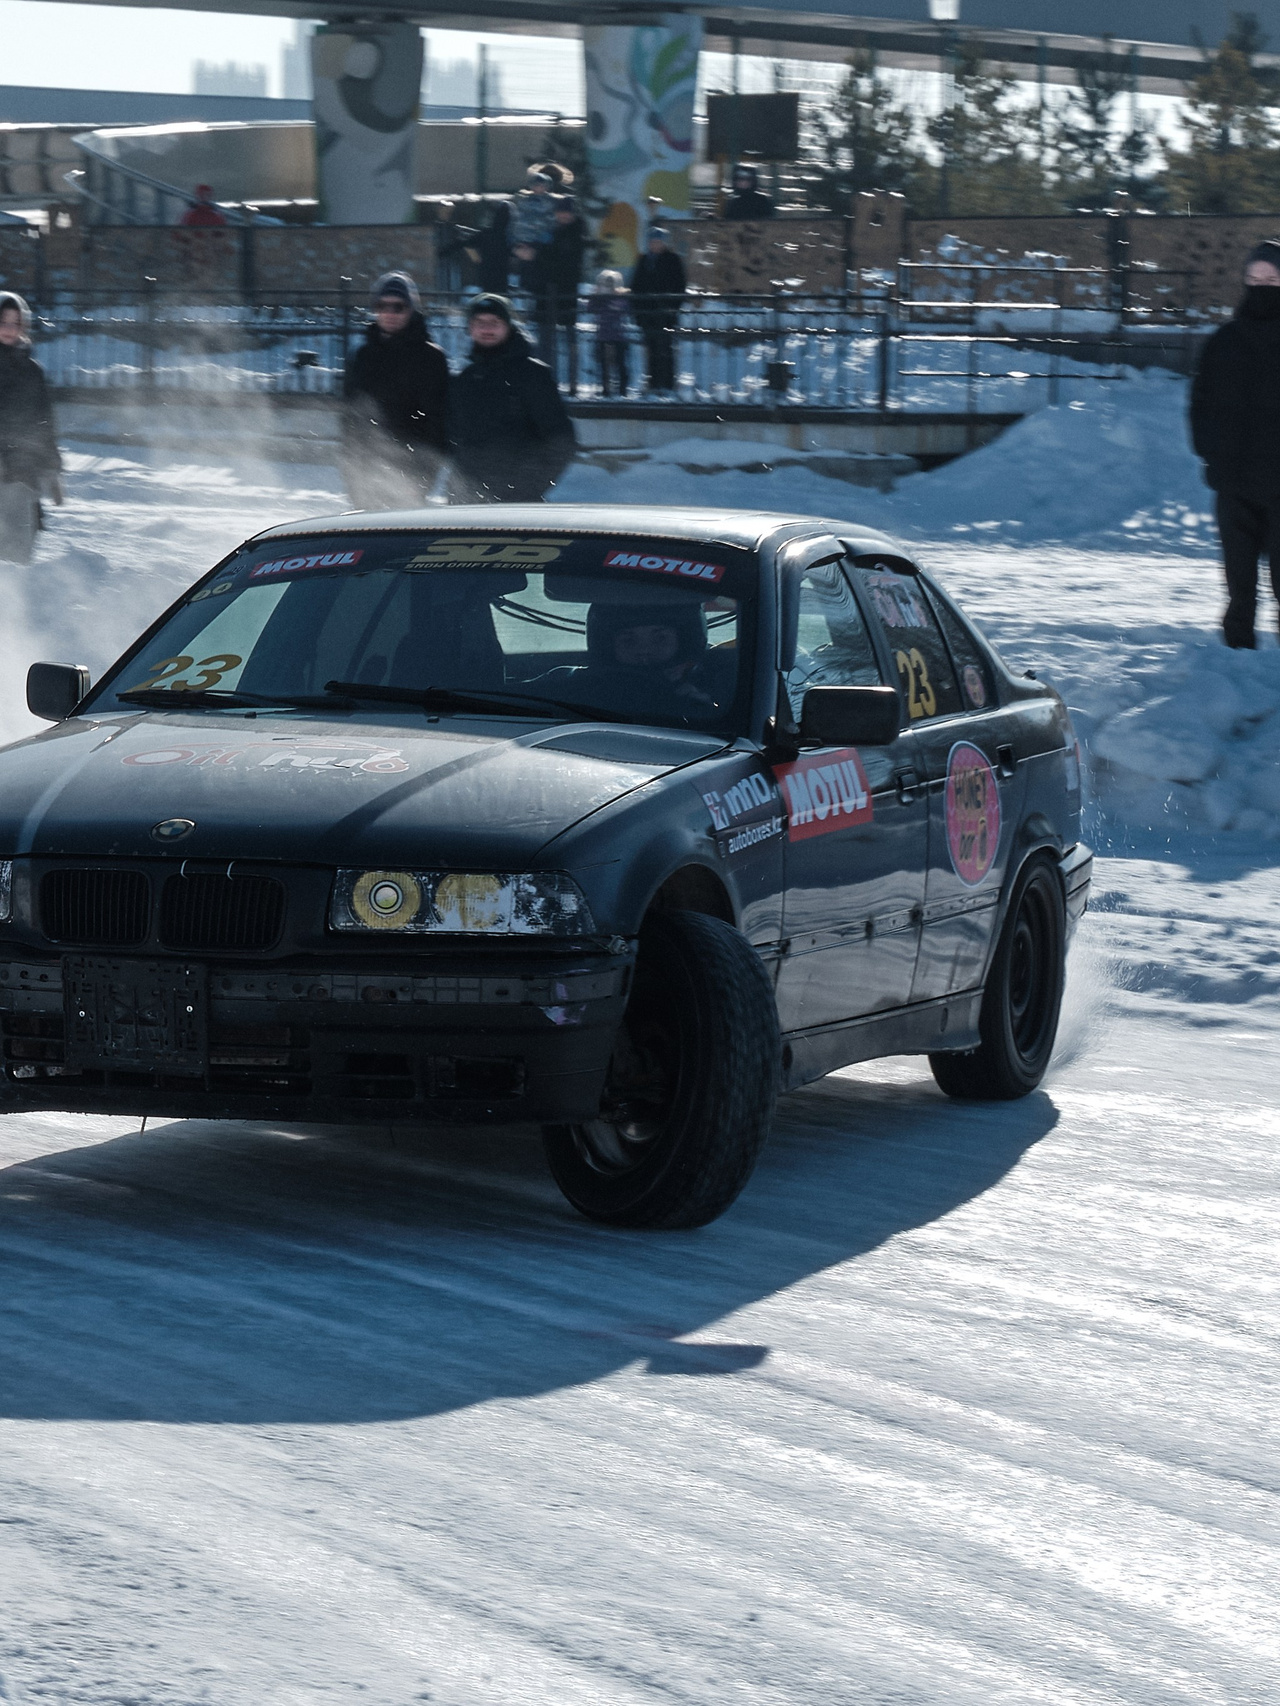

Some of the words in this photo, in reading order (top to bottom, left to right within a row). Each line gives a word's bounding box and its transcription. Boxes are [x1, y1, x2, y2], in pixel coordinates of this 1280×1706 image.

[253, 552, 356, 577] MOTUL
[404, 562, 445, 570] SNOW
[609, 553, 718, 580] MOTUL
[123, 654, 243, 692] 23
[896, 647, 937, 719] 23
[785, 760, 868, 827] MOTUL
[728, 816, 783, 854] autoboxes.kz
